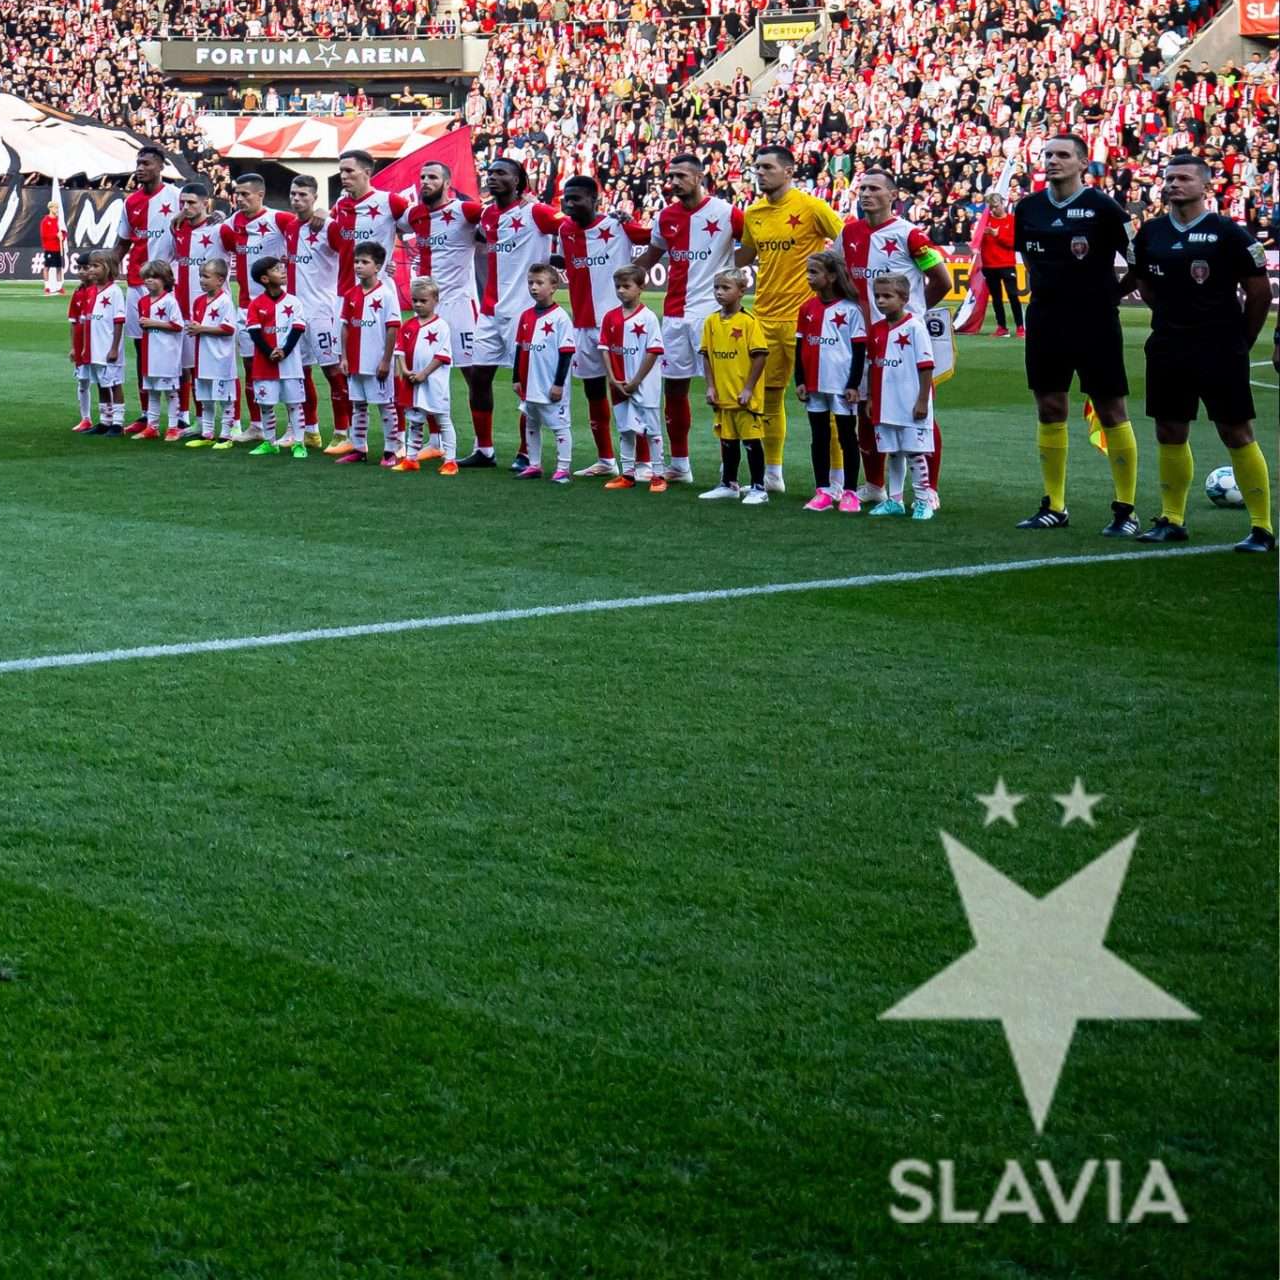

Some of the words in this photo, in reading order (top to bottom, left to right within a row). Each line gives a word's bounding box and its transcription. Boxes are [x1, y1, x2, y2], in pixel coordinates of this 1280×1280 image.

[196, 48, 311, 65] FORTUNA
[344, 47, 426, 64] ARENA
[317, 331, 332, 349] 21
